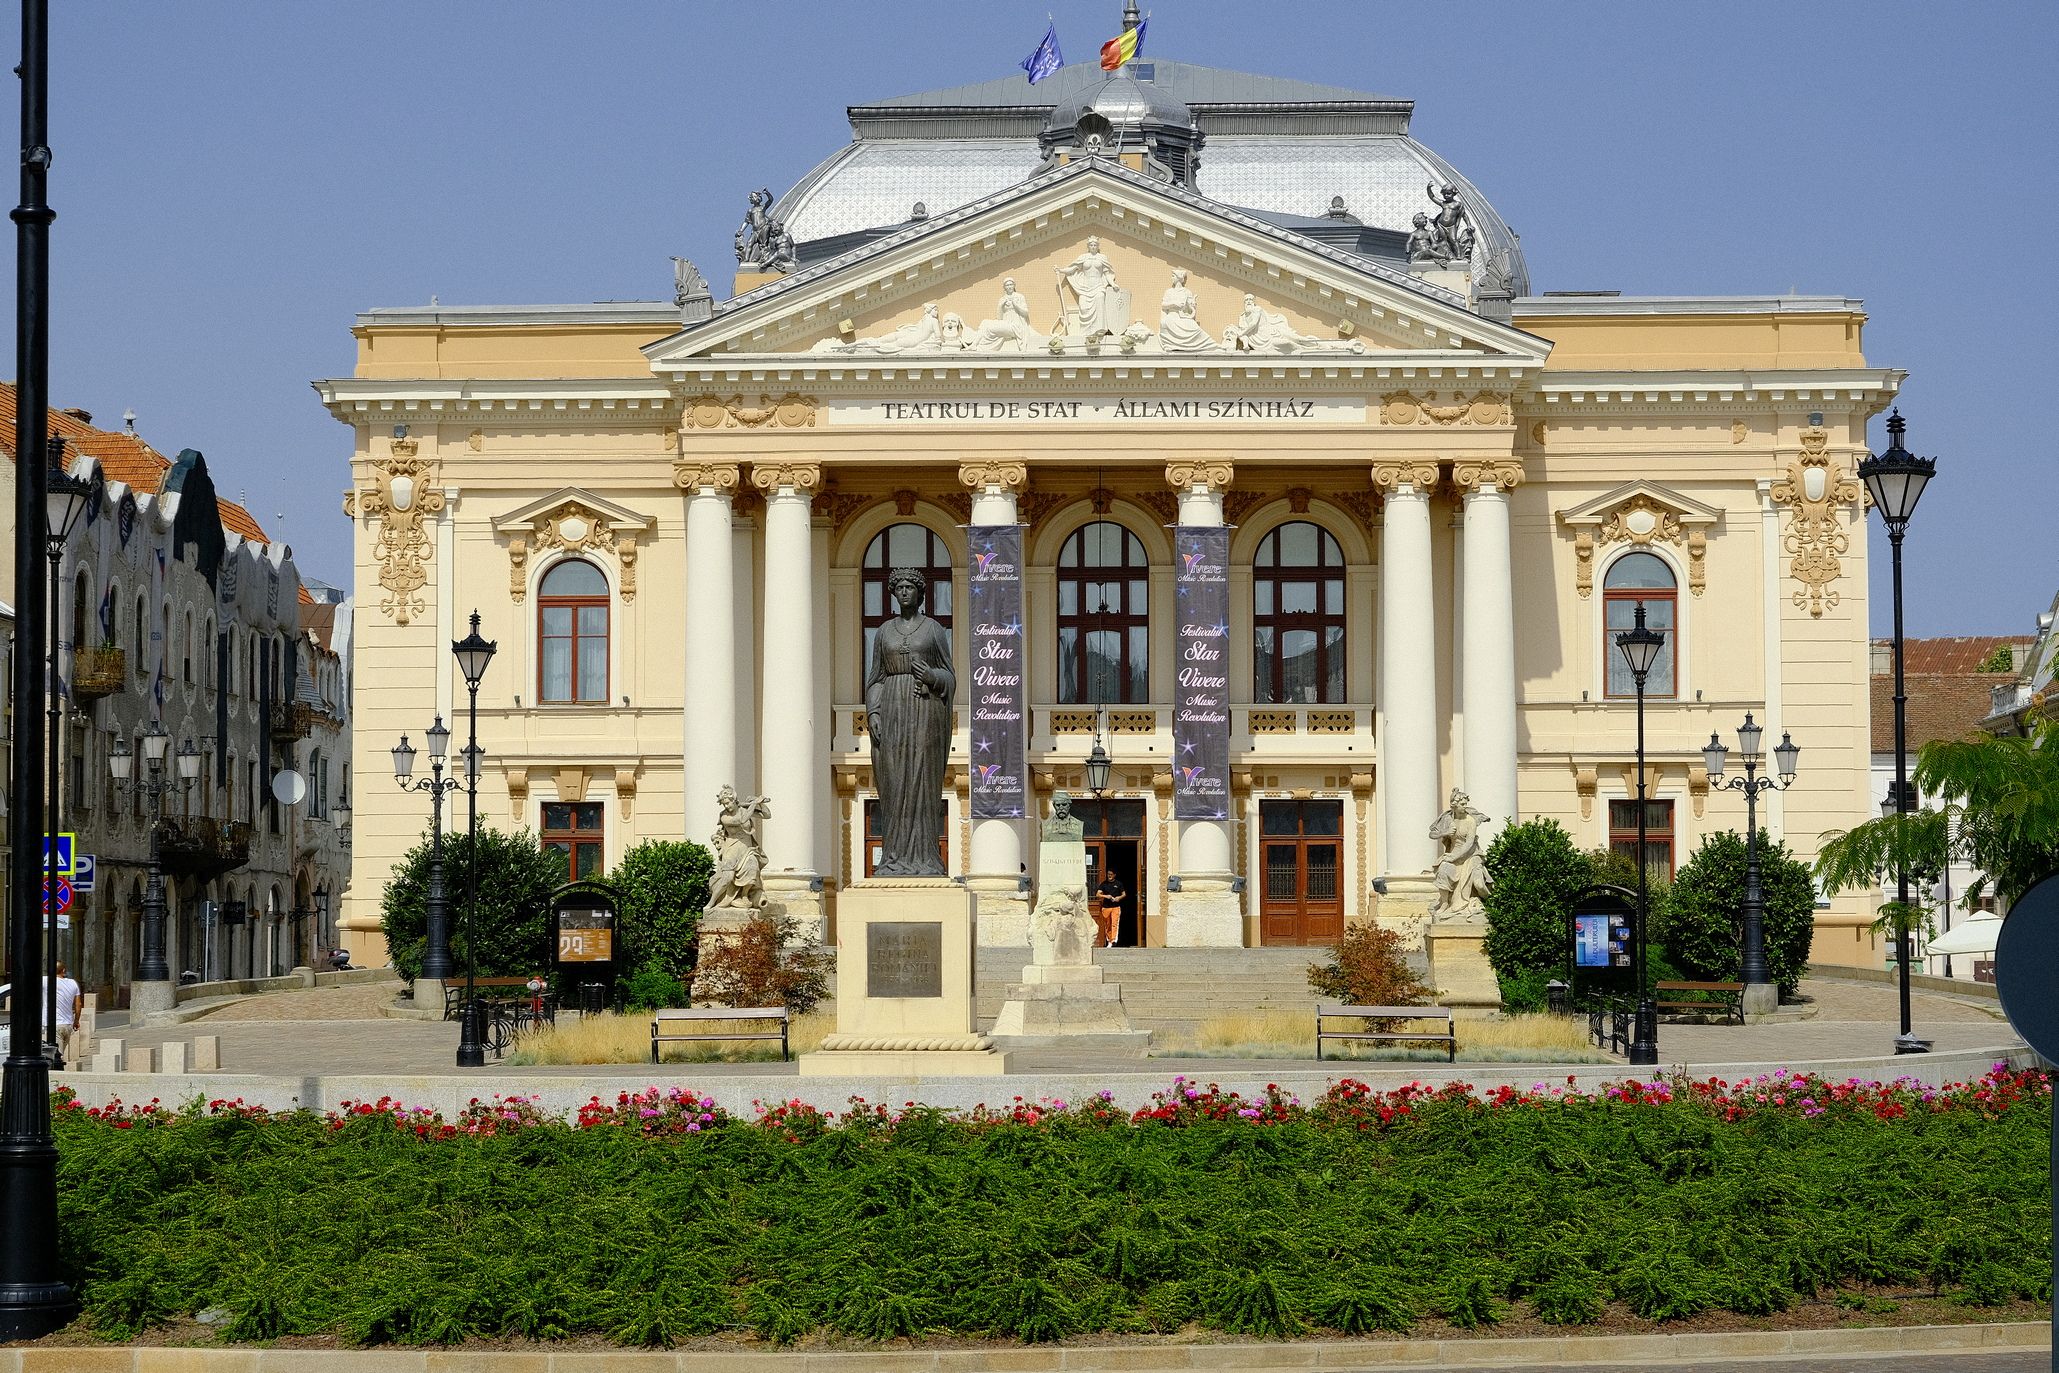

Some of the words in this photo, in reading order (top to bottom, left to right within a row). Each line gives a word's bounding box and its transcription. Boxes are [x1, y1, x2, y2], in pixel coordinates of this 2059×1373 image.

[881, 402, 984, 419] TEATRUL
[989, 402, 1020, 419] DE
[1027, 402, 1082, 418] STAT
[1113, 398, 1201, 418] ÁLLAMI
[1208, 398, 1314, 418] SZÍNHÁZ
[974, 623, 1016, 636] Festivalul
[1180, 624, 1222, 637] Festivalul
[979, 639, 1014, 659] Star
[1184, 640, 1220, 661] Star
[973, 666, 1020, 686] Vivere
[1178, 667, 1226, 688] Vivere
[981, 692, 1013, 705] Music
[1185, 693, 1217, 706] Music
[972, 707, 1020, 720] Revolution
[1177, 709, 1227, 722] Revolution
[70, 856, 93, 881] P
